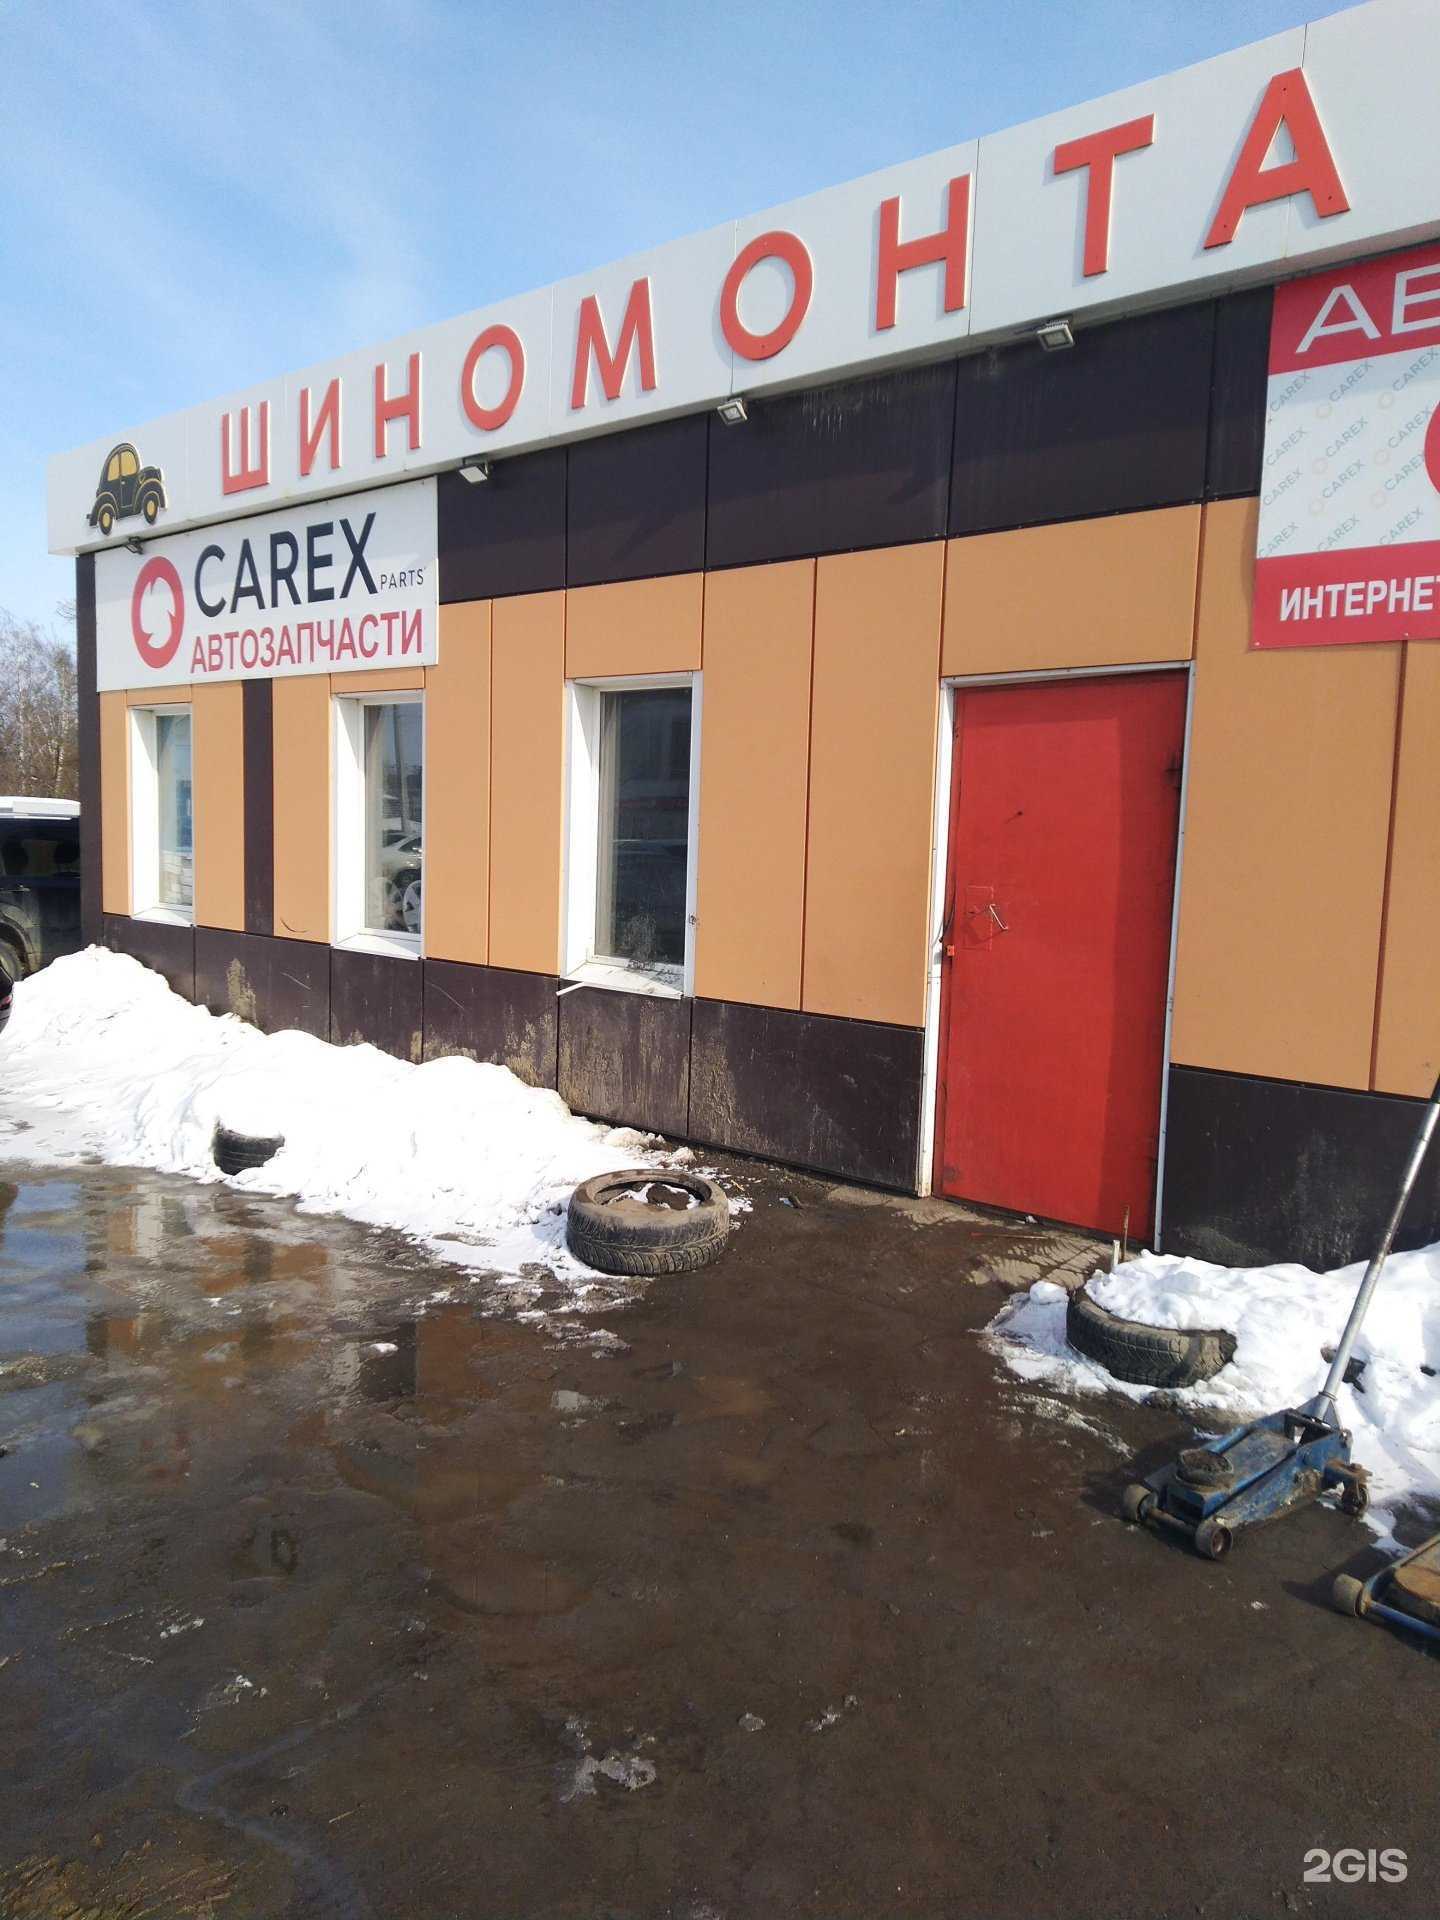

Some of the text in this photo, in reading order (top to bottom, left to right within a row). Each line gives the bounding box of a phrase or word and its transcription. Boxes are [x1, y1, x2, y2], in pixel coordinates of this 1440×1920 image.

[222, 66, 1351, 495] ШИНОМОНТА
[1329, 360, 1374, 402] CAREX
[1392, 347, 1440, 391] CAREX
[1270, 370, 1311, 412] CAREX
[1266, 425, 1308, 467] CAREX
[1325, 415, 1368, 457] CAREX
[1388, 406, 1432, 449] CAREX
[1263, 468, 1304, 506] CAREX
[1322, 458, 1366, 499] CAREX
[194, 511, 424, 618] CAREX PARTS
[1280, 574, 1440, 622] ИНТЕРНЕ
[190, 608, 424, 674] АВТОЗАПЧАСТИ
